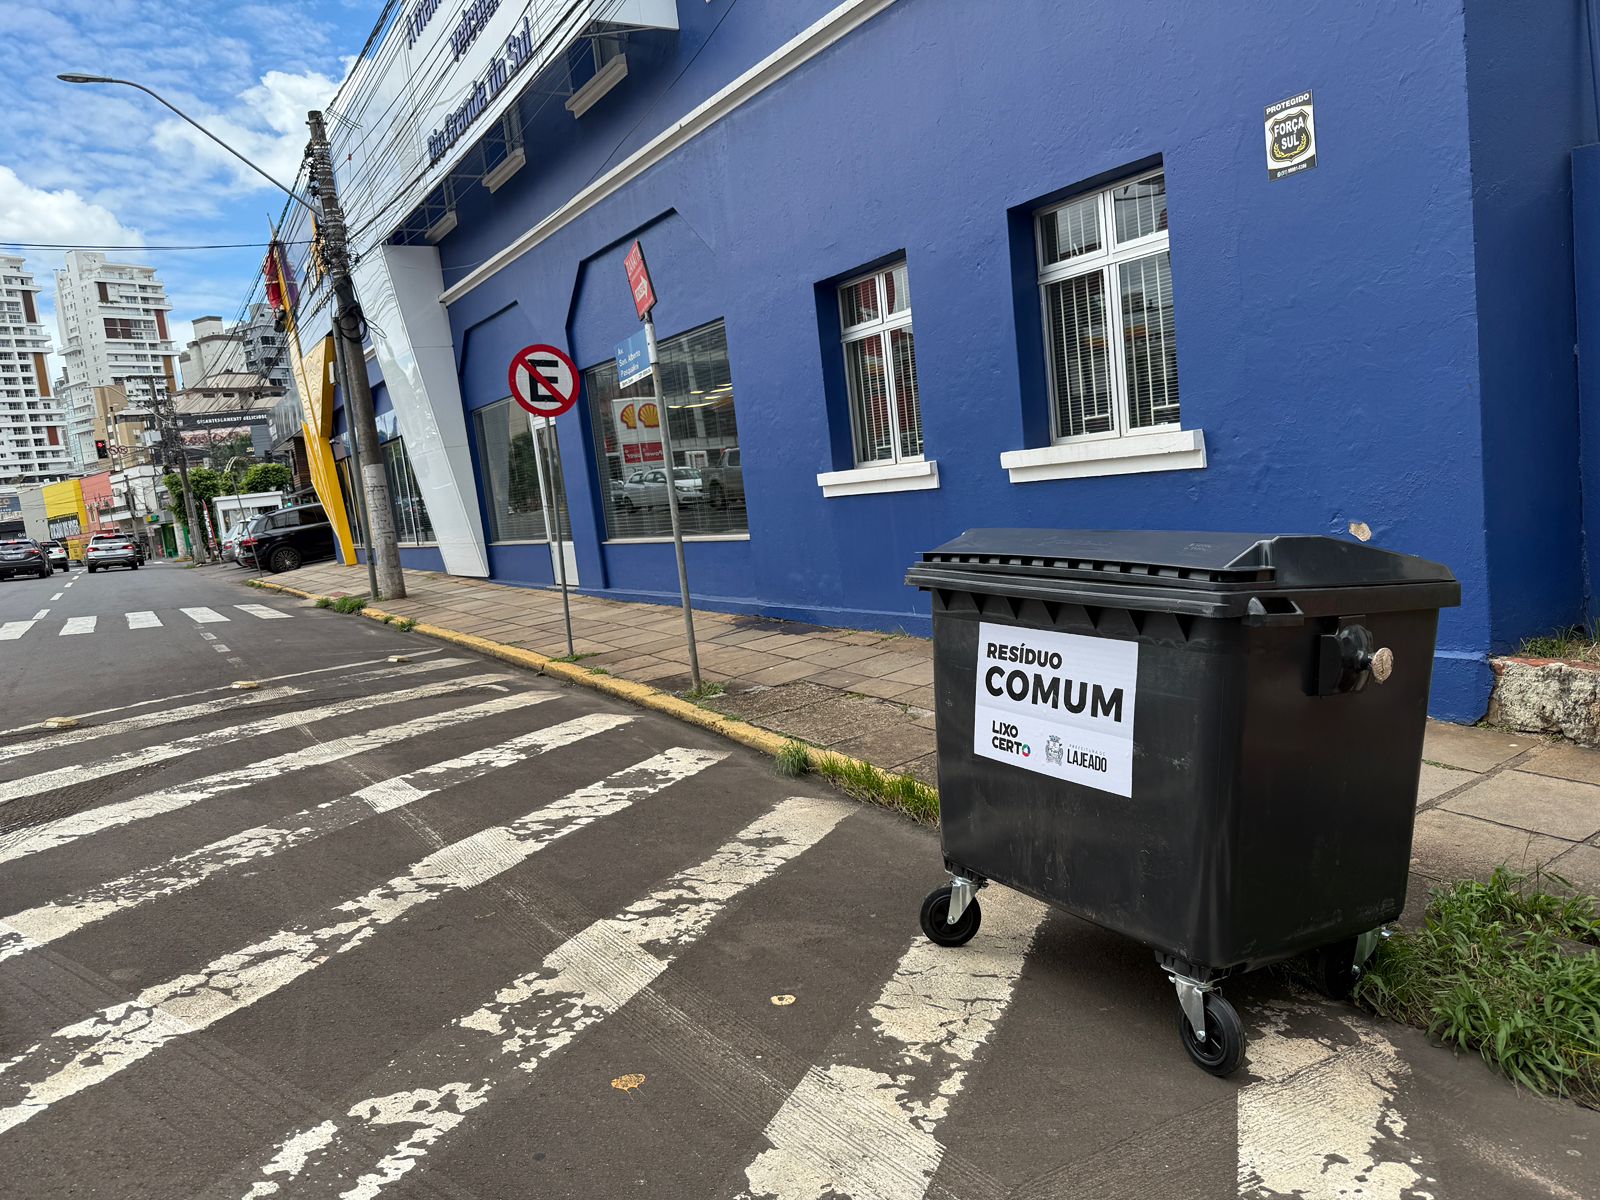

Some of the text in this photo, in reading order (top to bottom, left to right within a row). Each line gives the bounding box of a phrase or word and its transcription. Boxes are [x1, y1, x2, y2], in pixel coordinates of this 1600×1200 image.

[427, 16, 533, 168] Rio Grande do Sul
[1266, 93, 1309, 115] PROTEGIDO
[1273, 116, 1305, 138] FORÇA
[1281, 134, 1300, 149] SUL
[627, 350, 641, 362] Alberto
[527, 359, 559, 402] E
[620, 361, 639, 378] Pasqualini
[986, 642, 1063, 670] RESÍDUO
[985, 665, 1124, 723] COMUM
[992, 720, 1019, 739] LIXO
[991, 736, 1032, 758] CERTO
[1066, 748, 1108, 773] LAJEADO
